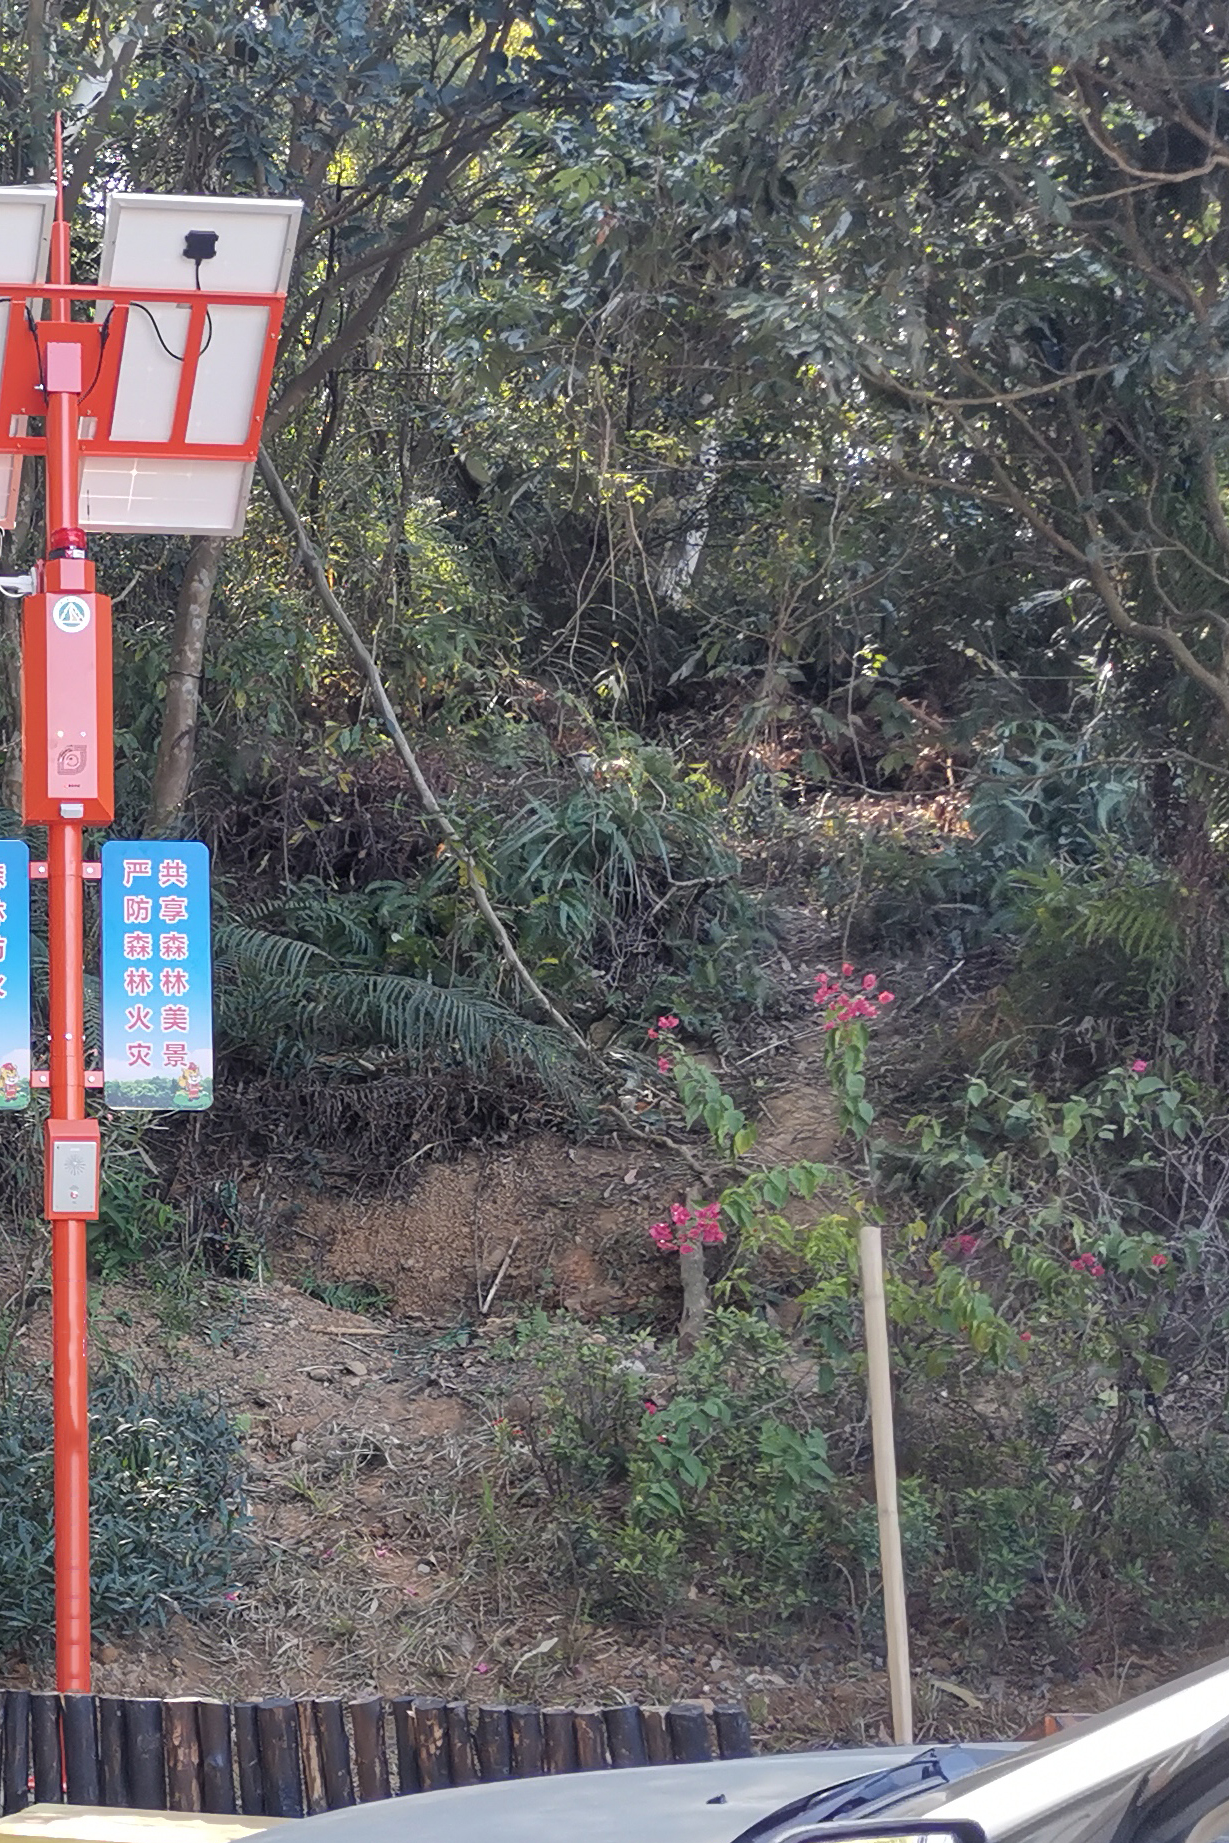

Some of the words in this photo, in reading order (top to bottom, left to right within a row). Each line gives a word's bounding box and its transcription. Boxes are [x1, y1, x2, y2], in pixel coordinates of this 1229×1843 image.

[123, 860, 153, 1067] 严防森林火灾
[159, 860, 189, 1068] 共享森林美景
